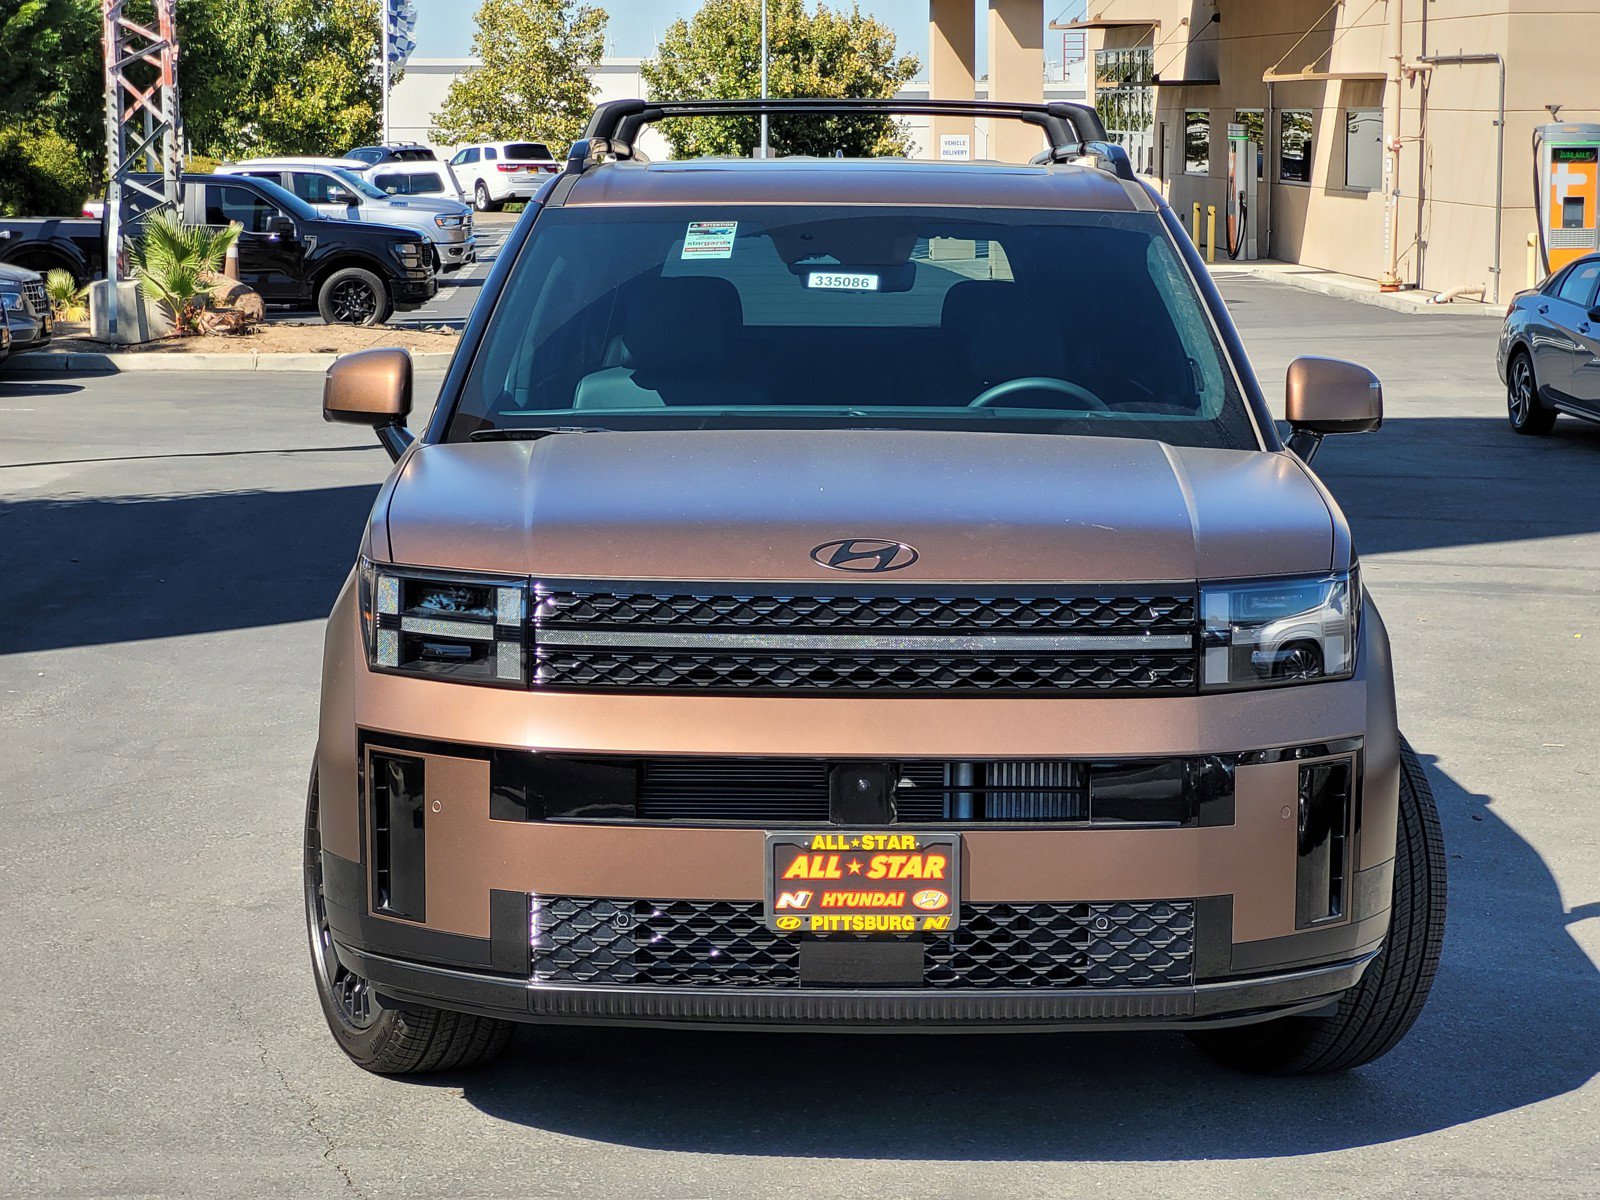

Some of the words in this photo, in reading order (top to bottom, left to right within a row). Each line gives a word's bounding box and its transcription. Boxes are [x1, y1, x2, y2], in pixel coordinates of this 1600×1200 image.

[814, 275, 870, 288] 335086
[811, 835, 850, 850] ALL
[861, 835, 916, 850] STAR
[781, 854, 843, 880] ALL
[866, 854, 948, 880] STAR
[820, 889, 907, 908] HYUNDAI
[811, 915, 916, 931] PITTSBURG
